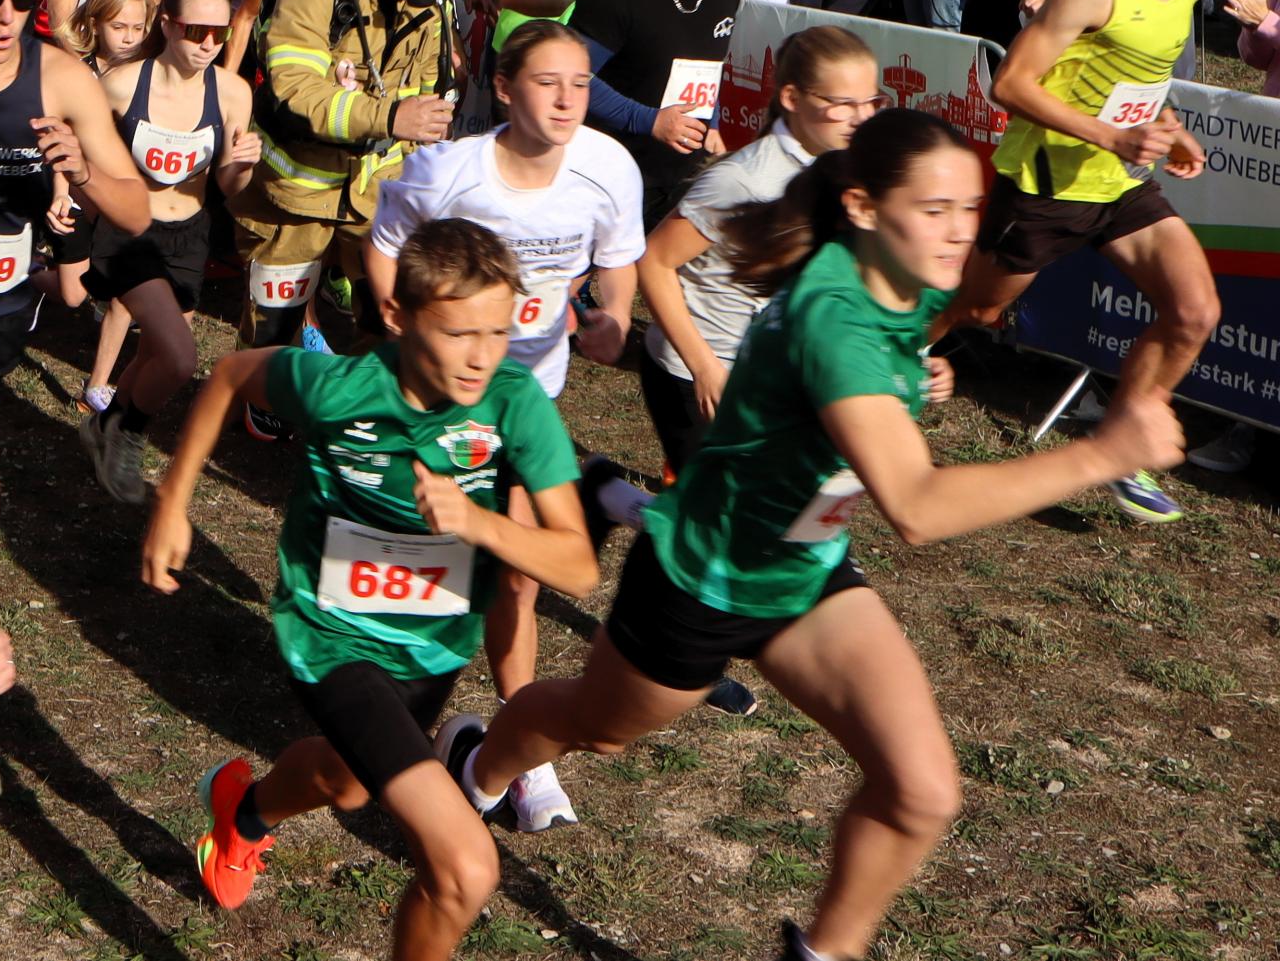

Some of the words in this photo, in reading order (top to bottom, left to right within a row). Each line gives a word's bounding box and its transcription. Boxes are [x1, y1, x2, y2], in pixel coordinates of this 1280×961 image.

[679, 81, 717, 109] 463
[1112, 100, 1159, 124] 354
[145, 147, 198, 174] 661
[262, 277, 311, 300] 167
[1091, 281, 1158, 324] Meh
[350, 560, 448, 601] 687
